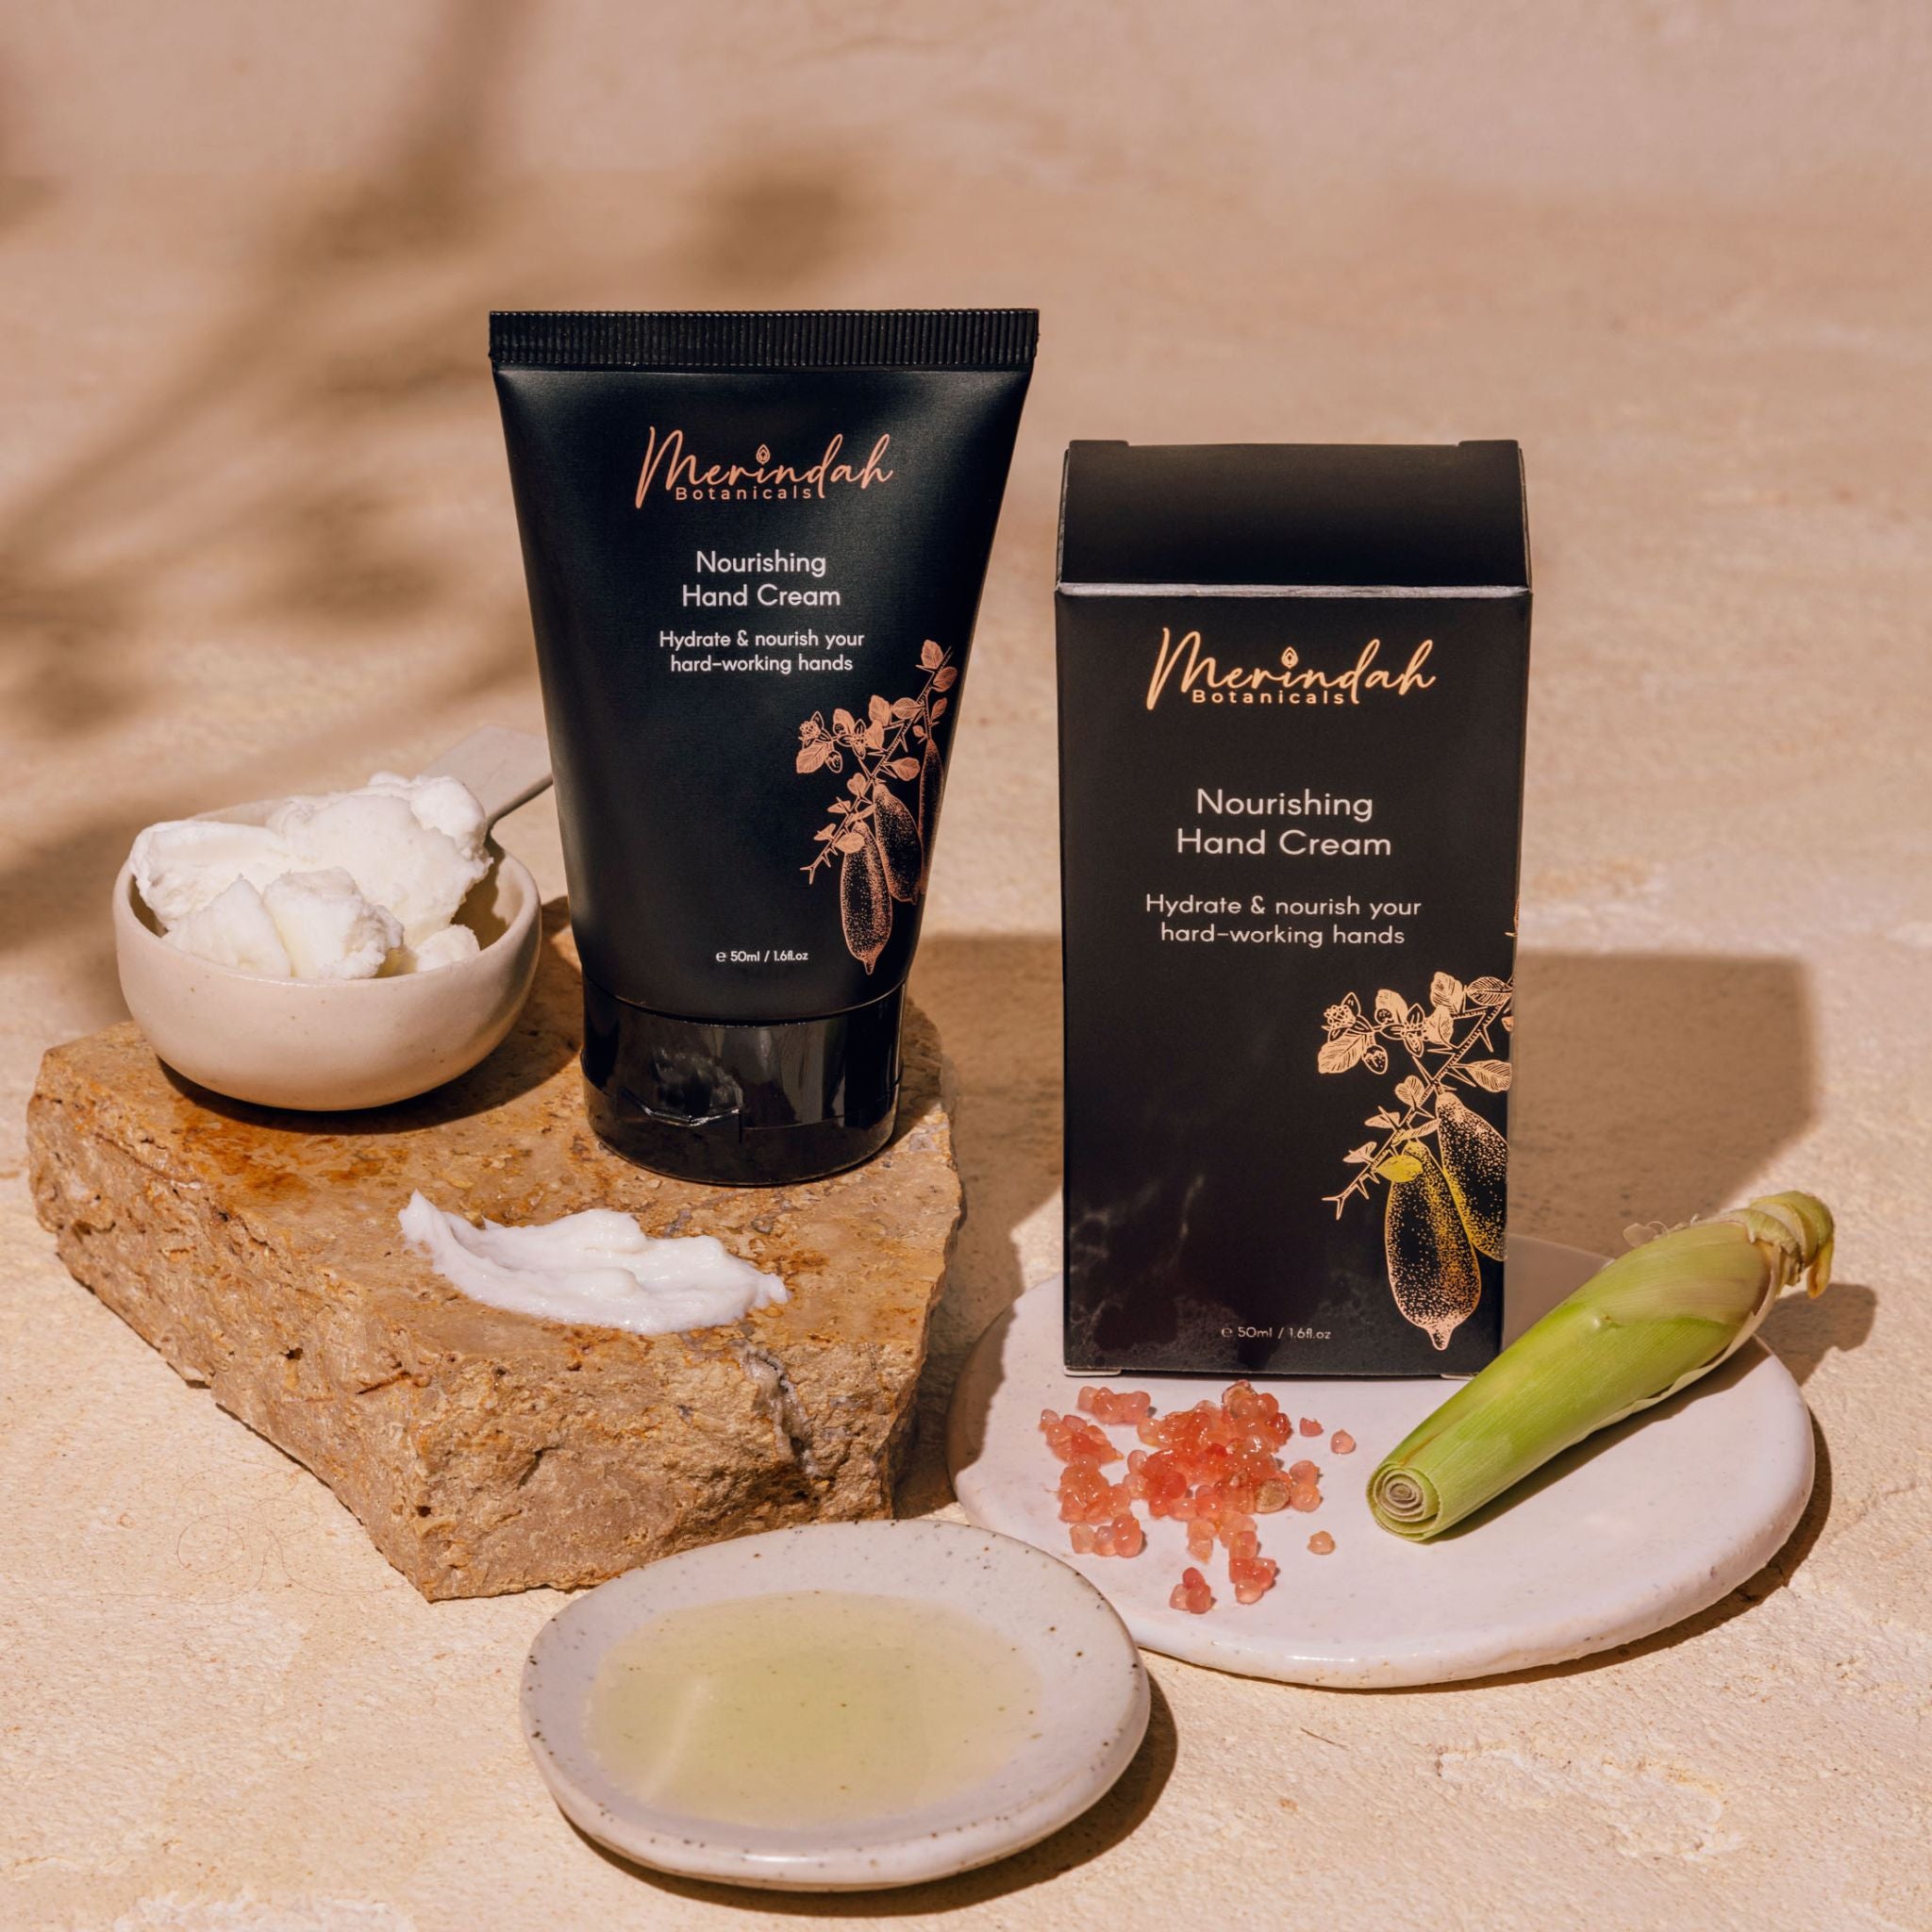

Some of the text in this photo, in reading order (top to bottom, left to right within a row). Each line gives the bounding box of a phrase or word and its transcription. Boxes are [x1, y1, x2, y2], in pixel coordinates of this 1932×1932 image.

[635, 426, 893, 508] Merindah
[675, 486, 811, 500] Botanicals
[696, 549, 826, 578] Nourishing
[682, 583, 841, 607] Hand Cream
[659, 629, 865, 651] Hydrate & nourish your
[671, 654, 853, 675] hard-working hands
[1146, 627, 1436, 710] Merindah
[1192, 690, 1344, 704] Botanicals
[1197, 788, 1374, 823] Nourishing
[1177, 828, 1391, 856] Hand Cream
[1146, 894, 1422, 920] Hydrate & nourish your
[1161, 922, 1405, 948] hard-working hands
[730, 951, 760, 962] 50ml
[764, 950, 770, 962] /
[1238, 1326, 1273, 1338] 50ml
[1278, 1327, 1284, 1340] /
